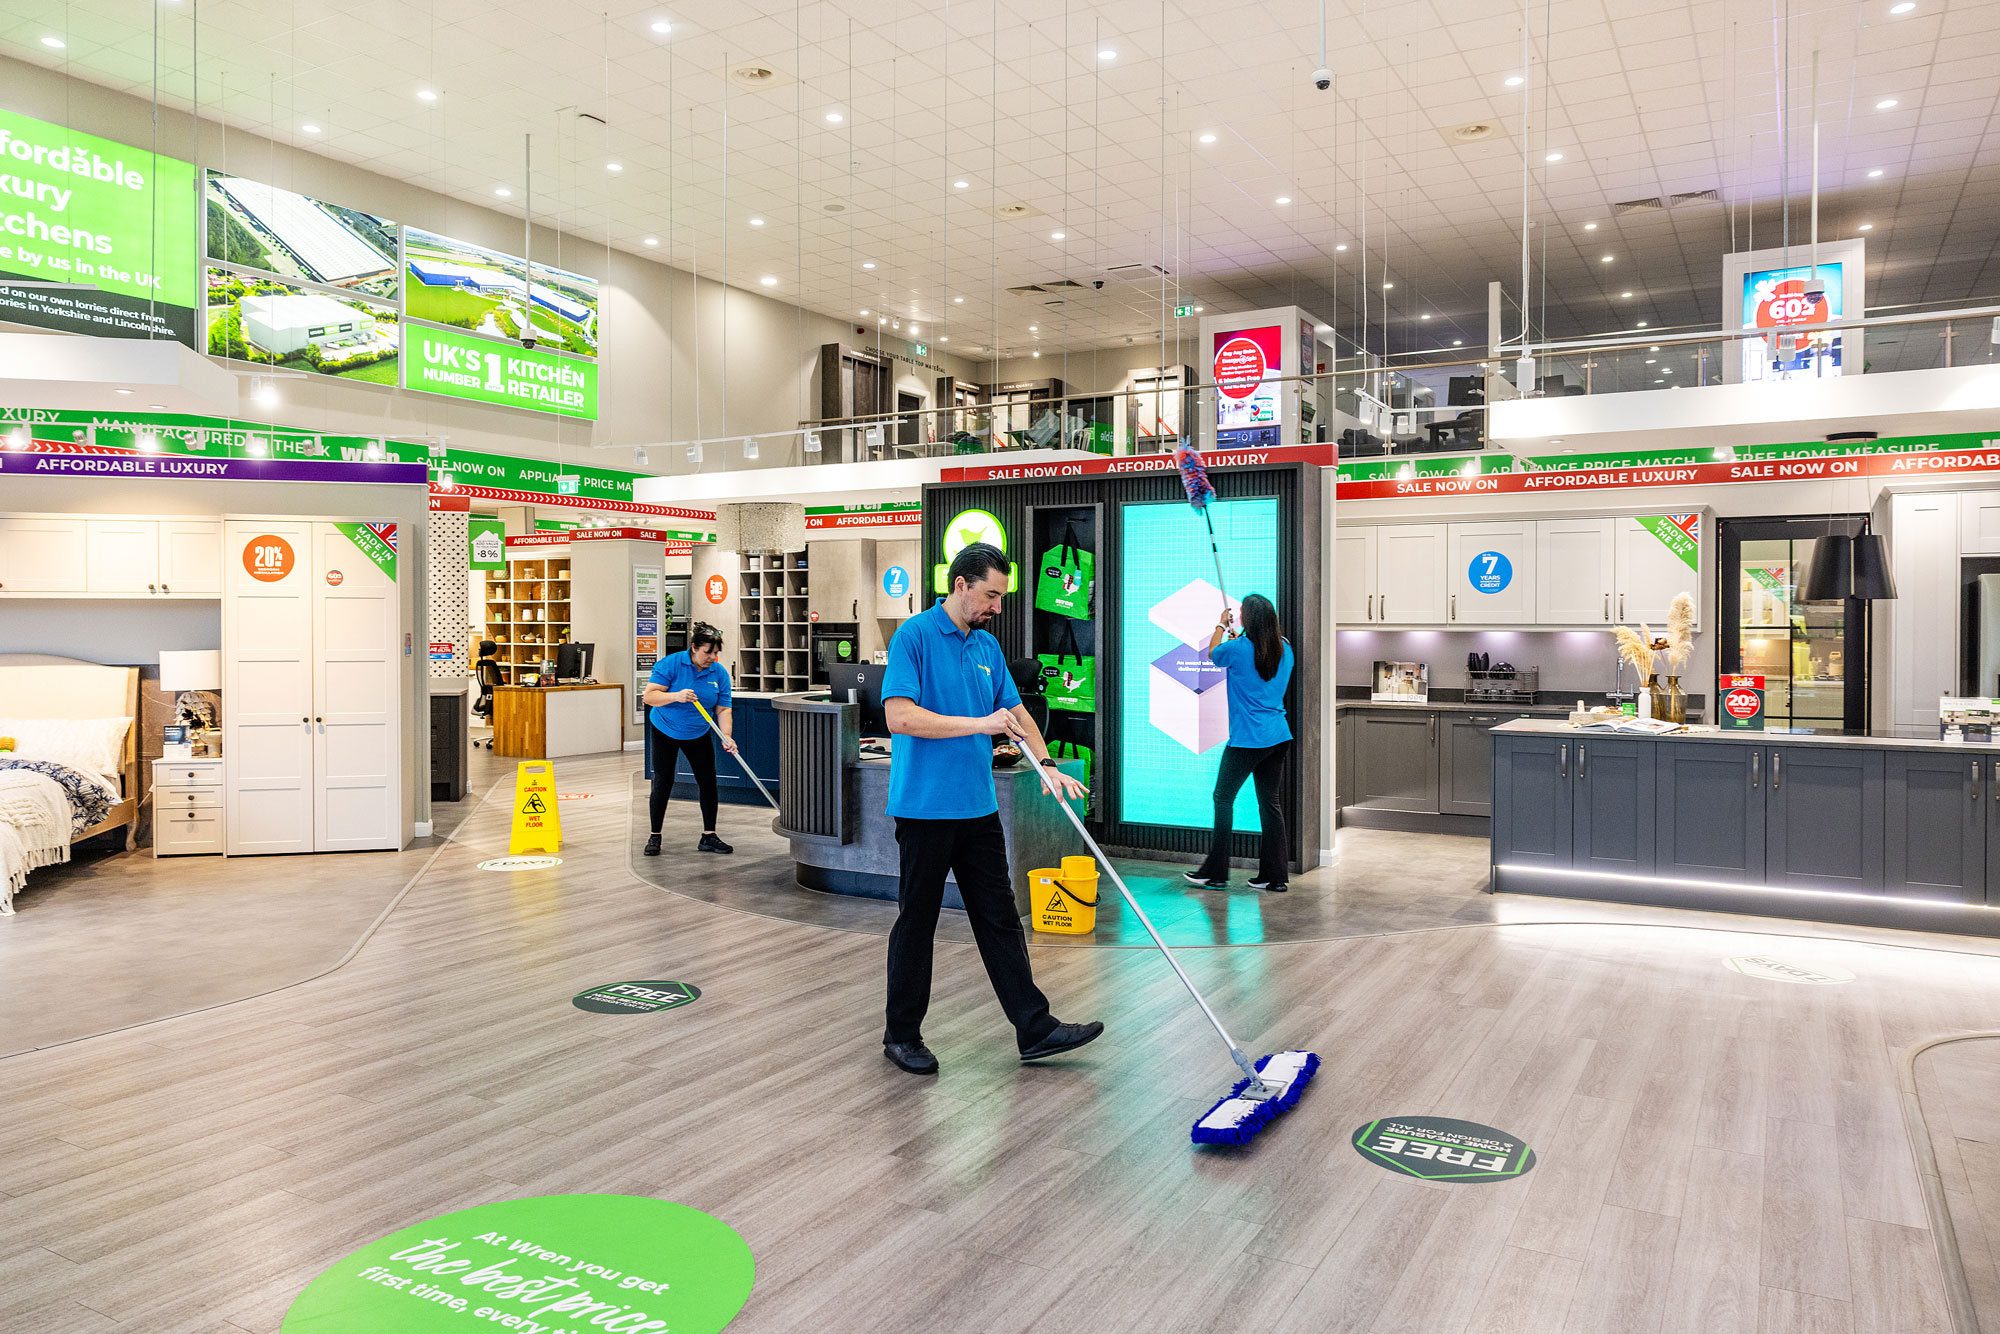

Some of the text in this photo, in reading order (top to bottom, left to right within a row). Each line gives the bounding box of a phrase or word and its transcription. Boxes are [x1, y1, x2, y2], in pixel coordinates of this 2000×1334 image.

[18, 246, 43, 267] by
[48, 255, 72, 271] us
[76, 258, 95, 276] in
[99, 264, 131, 282] the
[136, 272, 162, 289] UK
[11, 290, 26, 298] on
[28, 293, 48, 302] our
[50, 297, 73, 306] own
[75, 299, 108, 313] lorries
[110, 306, 139, 319] direct
[28, 302, 39, 311] in
[41, 305, 91, 321] Yorkshire
[93, 315, 112, 325] and
[424, 367, 481, 389] NUMBER
[484, 353, 505, 393] 1
[508, 379, 584, 408] RETAILER
[36, 458, 229, 475] AFFORDABLE LUXURY
[453, 462, 484, 475] NOW
[487, 466, 505, 478] ON
[584, 477, 614, 490] PRICE
[988, 468, 1020, 480] SALE
[1024, 466, 1056, 478] NOW
[1062, 464, 1082, 476] ON
[1208, 453, 1269, 467] LUXURY
[1397, 482, 1432, 494] SALE
[1435, 480, 1472, 492] NOW
[1476, 479, 1498, 490] ON
[1524, 472, 1628, 488] AFFORDABLE
[1632, 469, 1698, 483] LUXURY
[1730, 465, 1774, 478] SALE
[1780, 462, 1825, 475] NOW
[1830, 461, 1858, 473] ON
[576, 529, 656, 539] SALE NOW ON SALE
[810, 518, 823, 527] ON
[836, 515, 893, 526] AFFORDABLE
[357, 526, 394, 561] MADE IN
[513, 536, 552, 545] AFFORDABLE
[1655, 526, 1686, 555] THE UK
[1658, 519, 1695, 551] MADE IN
[353, 534, 386, 564] THE UK
[891, 569, 902, 584] 7
[1482, 556, 1498, 575] 7
[1042, 914, 1073, 922] CAUTION
[1056, 920, 1072, 928] FLOOR
[1743, 957, 1812, 977] DAYS
[606, 984, 689, 1003] FREE
[1384, 1126, 1512, 1153] HOME MEASURE
[1389, 1122, 1415, 1130] ALL
[1416, 1127, 1445, 1136] FOR
[1447, 1132, 1500, 1146] DESIGN
[1372, 1135, 1508, 1173] FREE
[389, 1237, 472, 1275] the
[459, 1257, 580, 1303] best
[472, 1231, 670, 1295] At Wren you get
[357, 1266, 549, 1334] first time, every
